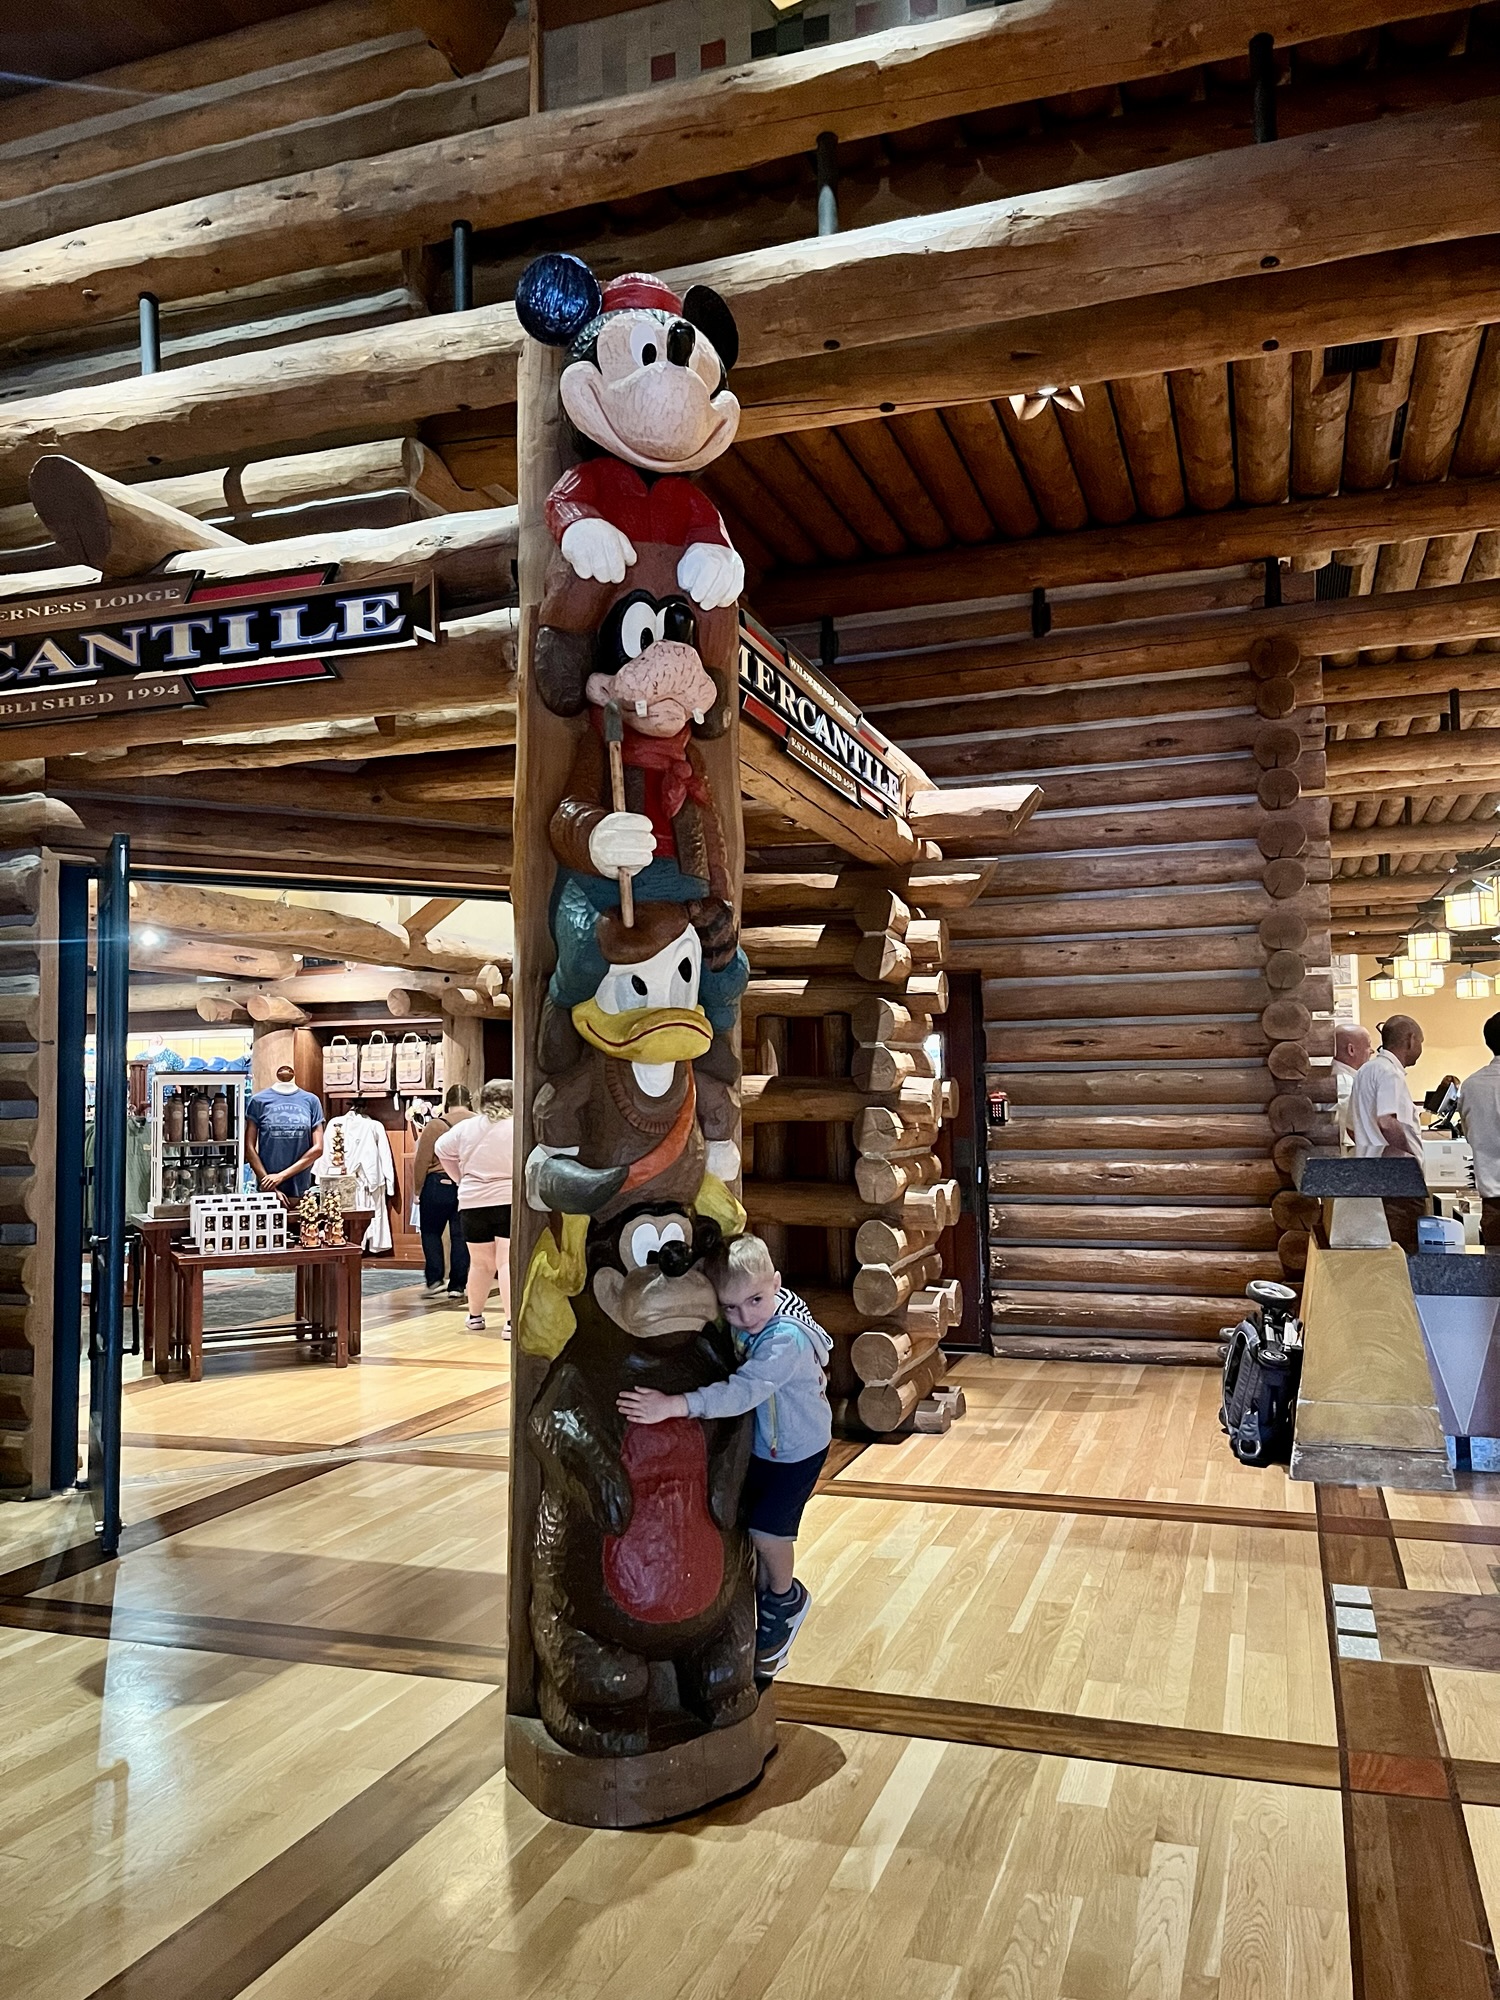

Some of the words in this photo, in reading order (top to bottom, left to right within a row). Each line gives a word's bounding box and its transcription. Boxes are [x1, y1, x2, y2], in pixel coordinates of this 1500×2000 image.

[95, 588, 181, 609] LODGE
[0, 692, 114, 715] BLISHED
[127, 684, 181, 701] 1994
